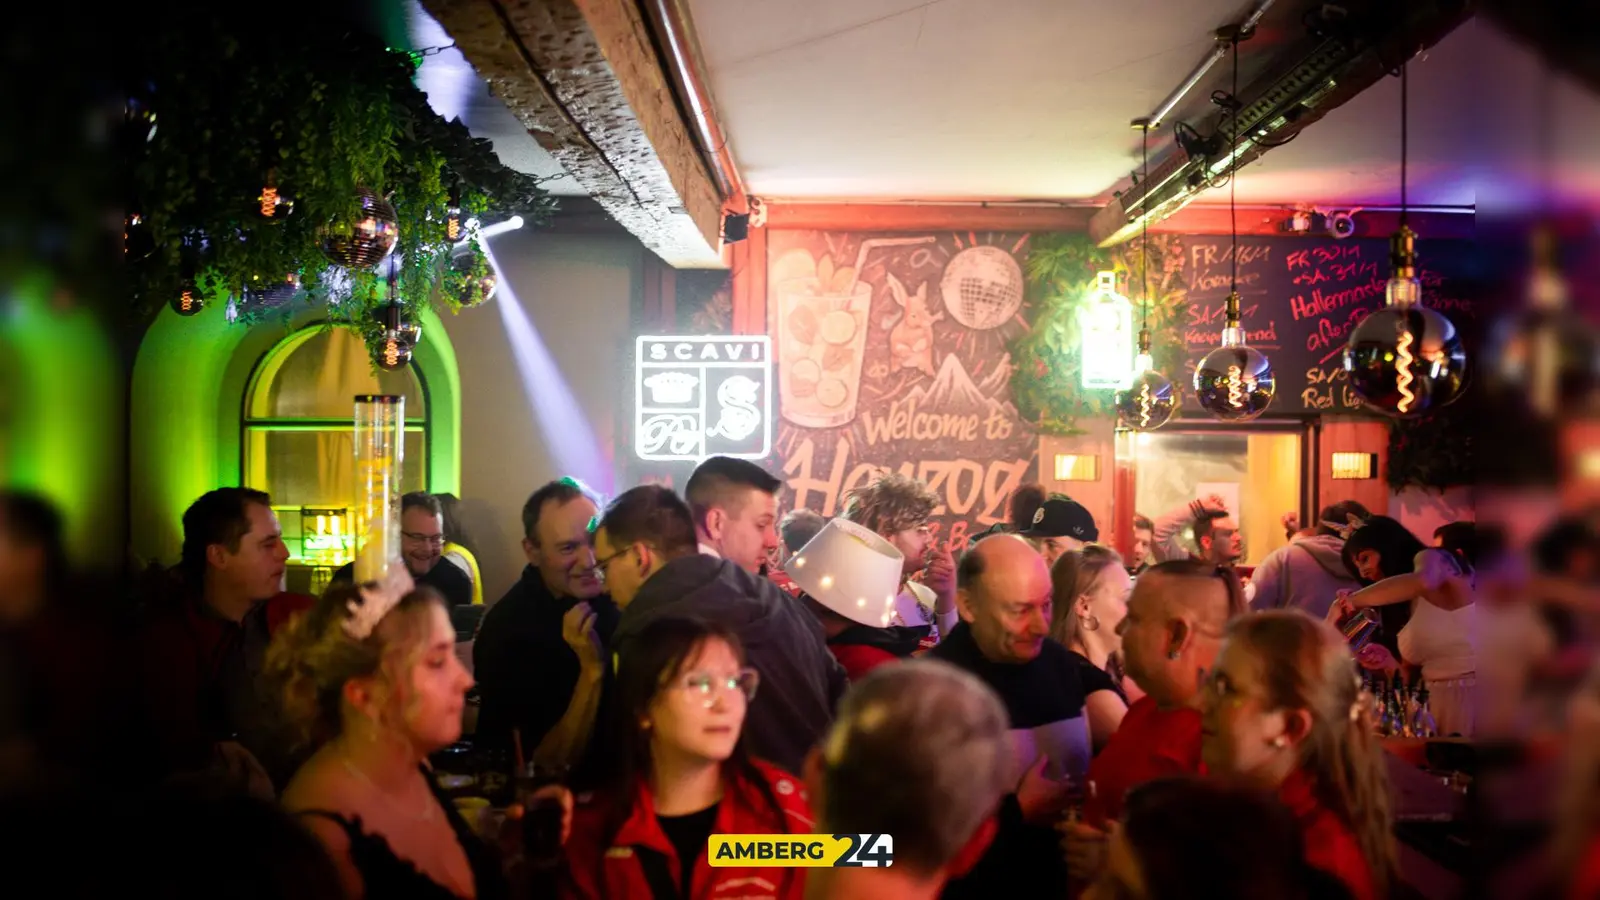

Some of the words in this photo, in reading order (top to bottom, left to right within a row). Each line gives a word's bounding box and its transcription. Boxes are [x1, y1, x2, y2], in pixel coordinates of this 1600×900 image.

[650, 343, 760, 360] SCAVI
[1301, 386, 1335, 409] Red
[861, 399, 979, 446] Welcome
[982, 406, 1013, 441] to
